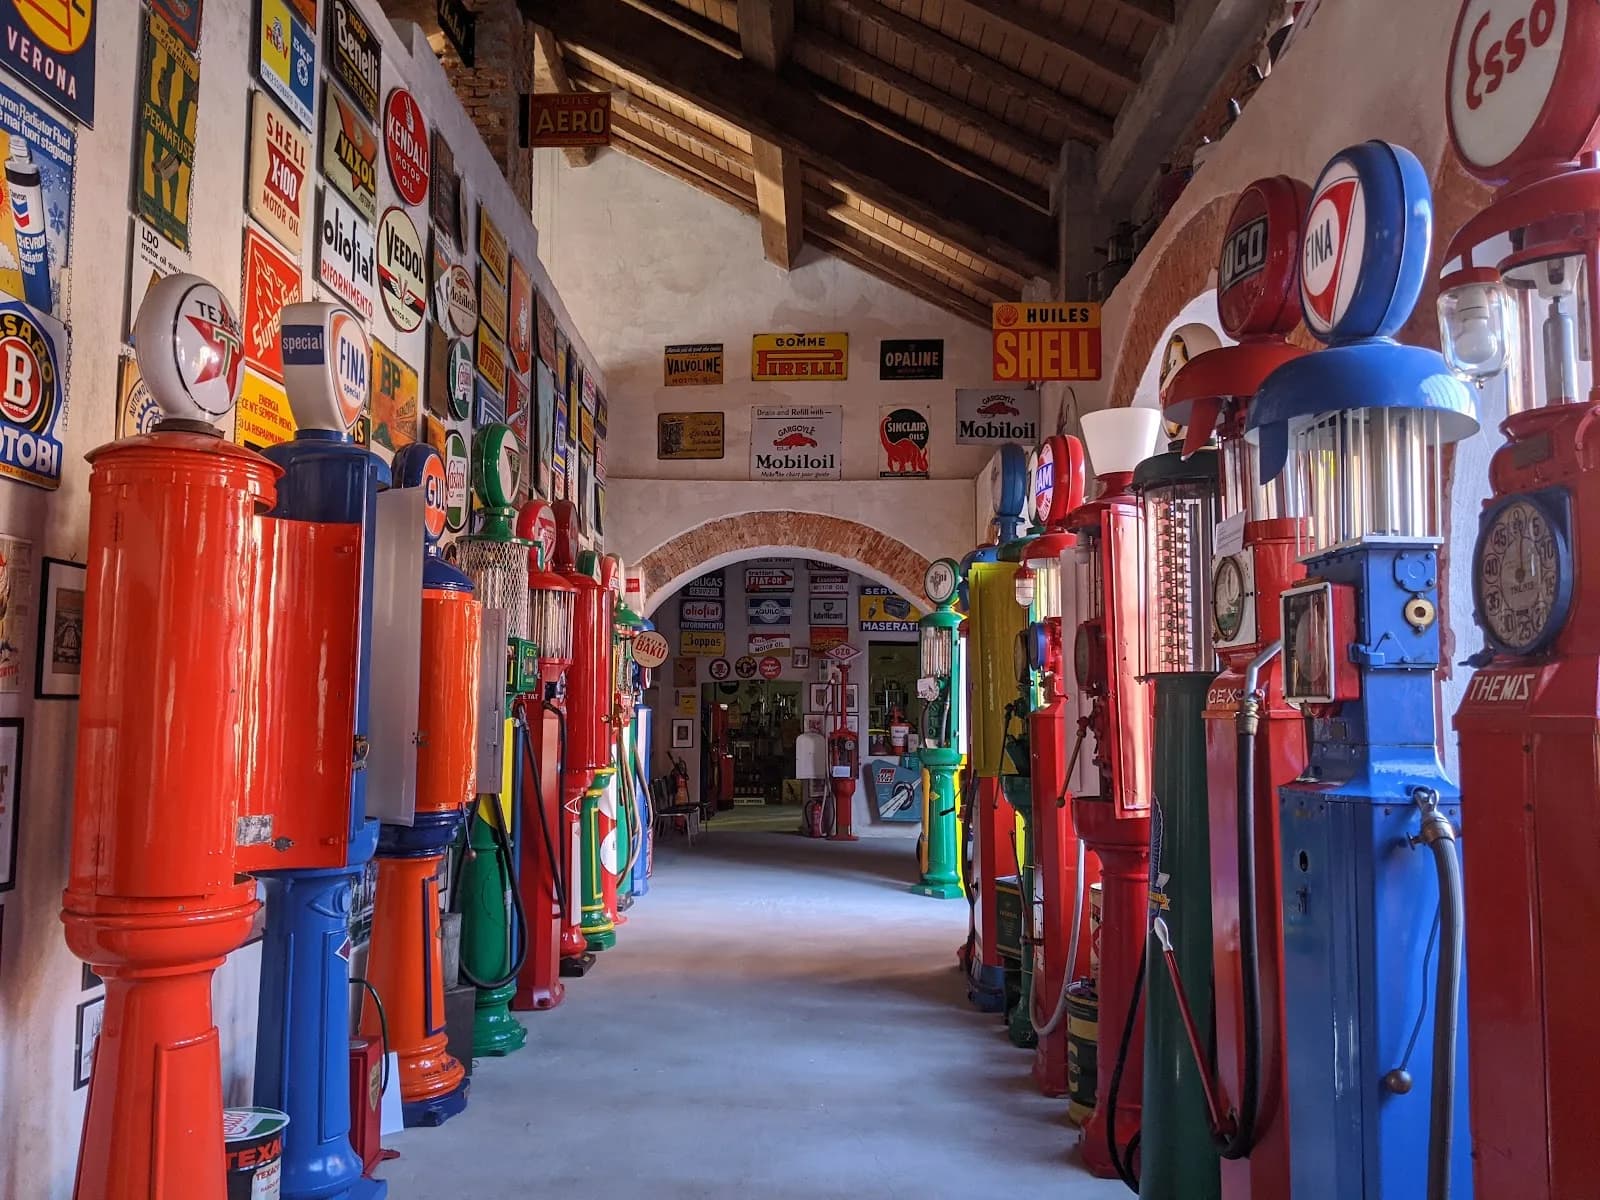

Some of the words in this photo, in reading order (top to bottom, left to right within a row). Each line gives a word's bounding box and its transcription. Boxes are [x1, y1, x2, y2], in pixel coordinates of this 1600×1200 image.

[334, 1, 379, 93] Benelli
[1466, 0, 1556, 110] Esso
[7, 26, 77, 100] VERONA
[143, 103, 194, 163] PERMAFUSE
[535, 107, 605, 135] AERO
[266, 112, 306, 170] SHELL
[388, 112, 429, 177] KENDALL
[271, 153, 297, 202] X-100
[395, 152, 421, 183] MOTOR
[402, 176, 415, 193] OIL
[262, 190, 287, 224] MOTOR
[289, 214, 299, 237] OIL
[141, 242, 159, 259] motor
[142, 226, 159, 248] LDO
[323, 208, 374, 287] oliofiat
[1305, 219, 1333, 277] FINA
[385, 220, 424, 284] VEEDOL
[1220, 222, 1265, 287] OCO
[321, 259, 373, 318] RIFORNIMENTO
[1027, 308, 1090, 323] HUILES
[282, 332, 324, 355] special
[775, 337, 826, 347] GOMME
[996, 331, 1097, 378] SHELL
[340, 336, 366, 392] FINA
[667, 357, 721, 376] VALVOLINE
[757, 349, 844, 376] PIRELLI
[885, 351, 939, 367] OPALINE
[3, 343, 33, 406] B
[381, 354, 401, 401] BP
[791, 408, 809, 416] Refill
[777, 425, 816, 437] GARGOYLE
[887, 422, 927, 432] SINCLAIR
[908, 432, 925, 441] OILS
[959, 420, 1036, 439] Mobiloil
[0, 425, 59, 477] TOBI
[756, 454, 835, 469] Mobiloil
[448, 460, 466, 498] Castrol
[1485, 559, 1498, 576] 40
[685, 601, 720, 618] oliofiat
[862, 622, 919, 631] MASERATI
[635, 640, 666, 659] BAKU
[1469, 674, 1536, 701] THEMIS
